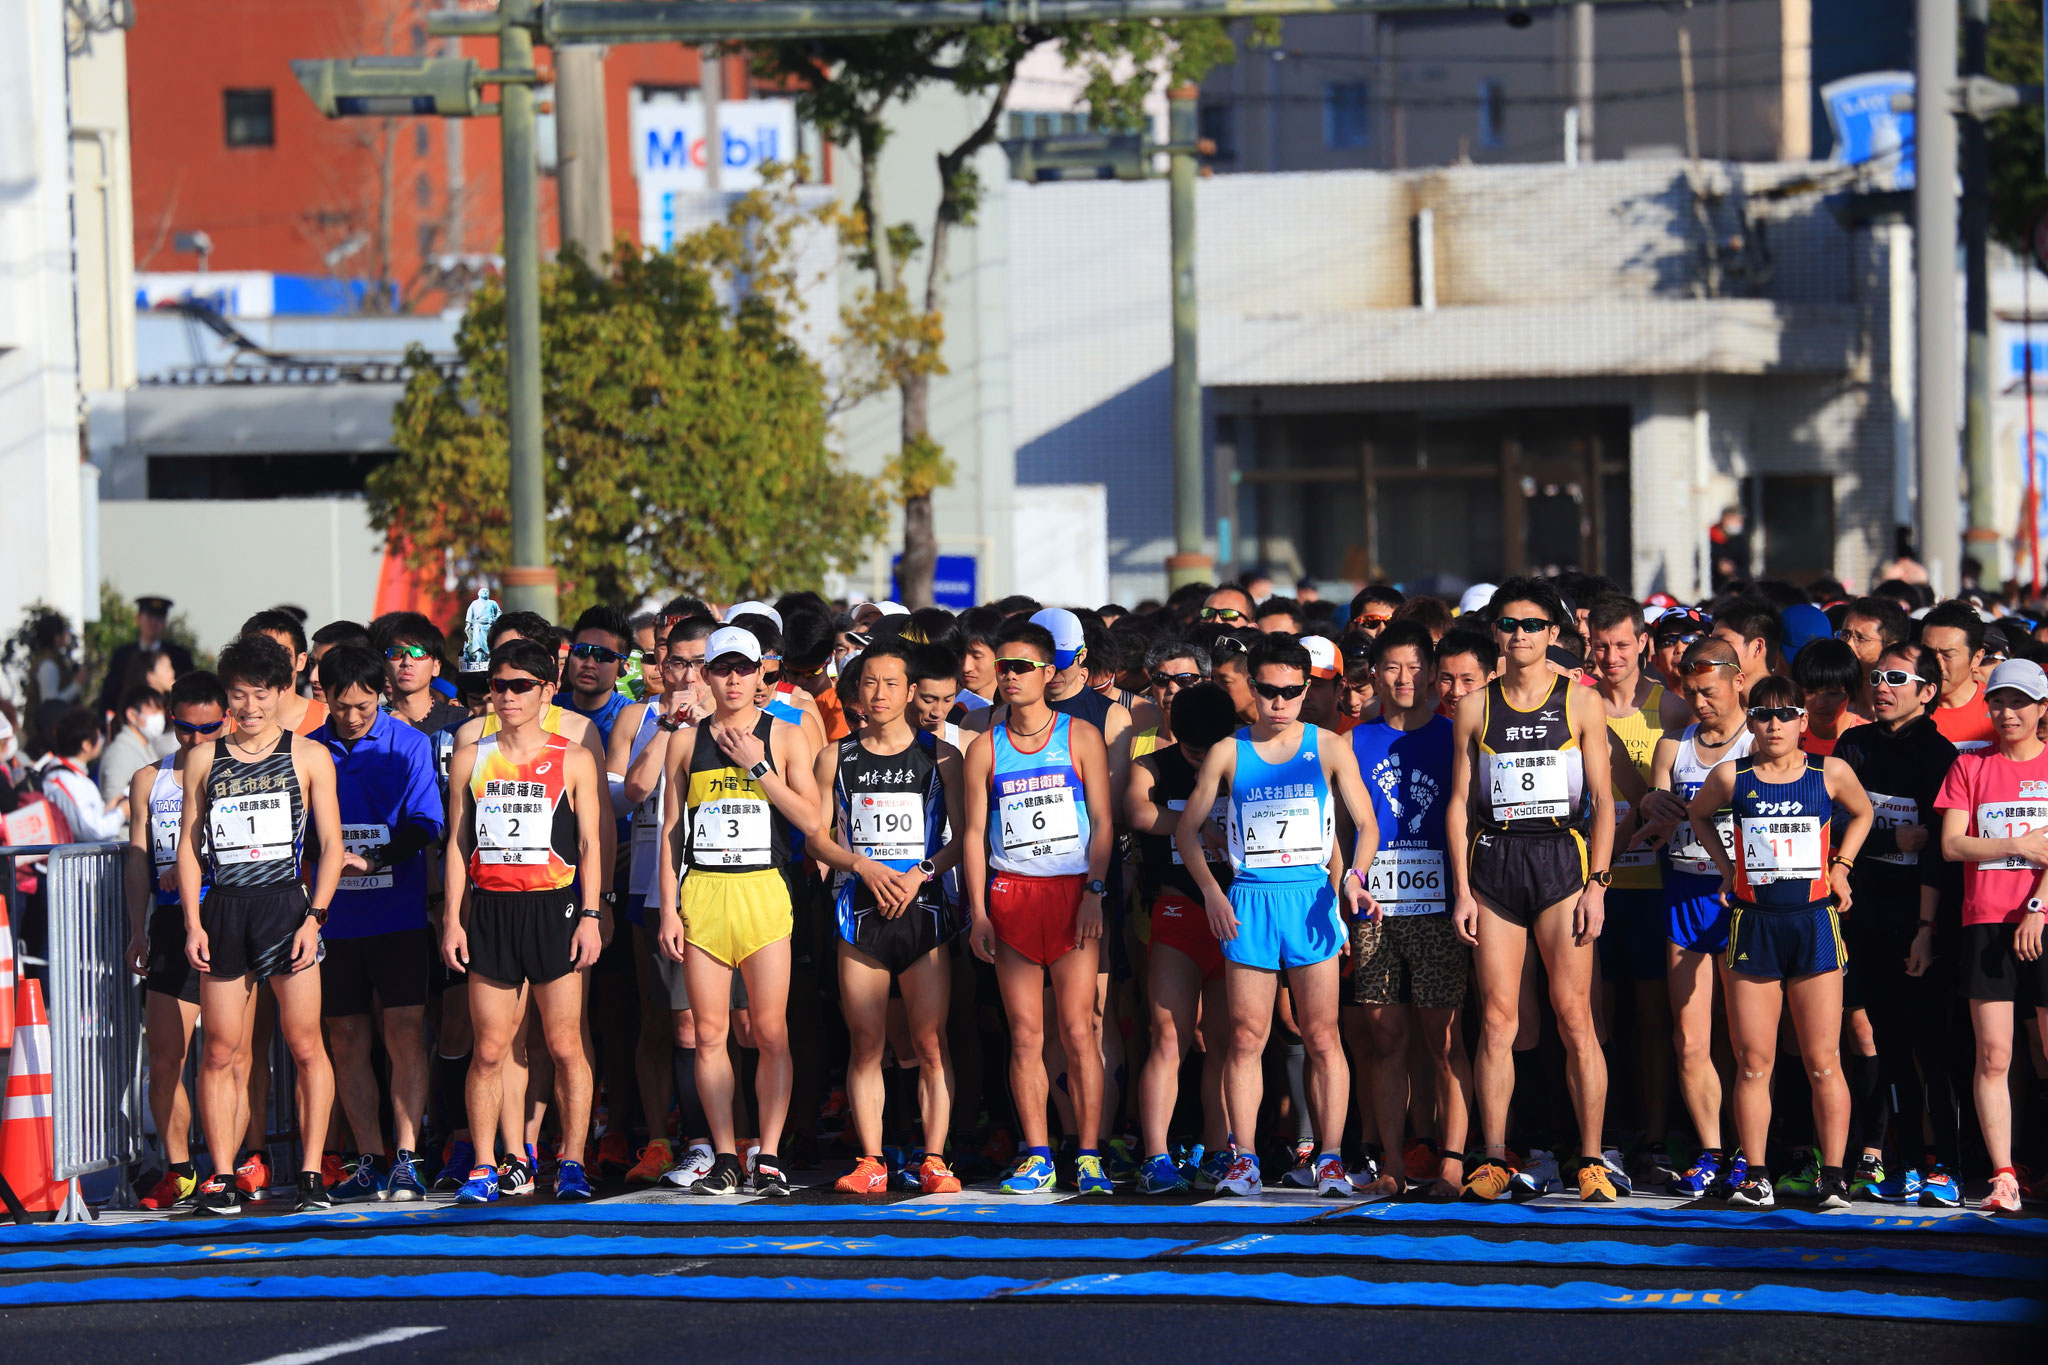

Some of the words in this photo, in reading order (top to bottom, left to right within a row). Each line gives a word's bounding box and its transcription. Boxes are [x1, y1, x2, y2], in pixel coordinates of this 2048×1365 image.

[1505, 725, 1548, 741] 京セラ
[1515, 756, 1557, 768] 健康家族
[214, 774, 288, 798] 日置市役所
[486, 782, 545, 799] 黒崎播磨
[1002, 774, 1066, 794] 国分自衛隊
[1493, 780, 1503, 794] A
[1521, 772, 1535, 791] 8
[1246, 783, 1314, 801] JAそお鹿児島
[156, 800, 182, 813] TAKI
[239, 798, 280, 812] 健康家族
[502, 803, 543, 814] 健康家族
[1024, 793, 1065, 809] 健康家族
[1755, 800, 1804, 816] ナンチク
[722, 804, 761, 815] 健康家族
[1252, 808, 1310, 819] JAグループ鹿児島
[1514, 806, 1555, 816] KYOCERA
[2005, 806, 2047, 818] 健康家族
[216, 824, 226, 838] A
[246, 815, 256, 835] 1
[479, 823, 488, 836] A
[508, 818, 520, 837] 2
[697, 824, 707, 838] A
[727, 819, 740, 838] 3
[852, 818, 862, 832] A
[873, 813, 913, 833] 190
[1004, 821, 1015, 836] A
[1032, 810, 1046, 830] 6
[1246, 827, 1257, 841] A
[1276, 820, 1289, 839] 7
[1769, 822, 1812, 834] 健康家族
[155, 839, 163, 852] A
[874, 847, 909, 857] MBC開発
[1031, 844, 1053, 858] 白波
[1387, 840, 1429, 849] HADASHI
[1747, 843, 1757, 858] A
[1769, 838, 1793, 857] 11
[503, 852, 522, 863] 白波
[722, 853, 743, 864] 白波
[1371, 876, 1381, 890] A
[1386, 870, 1440, 890] 1066
